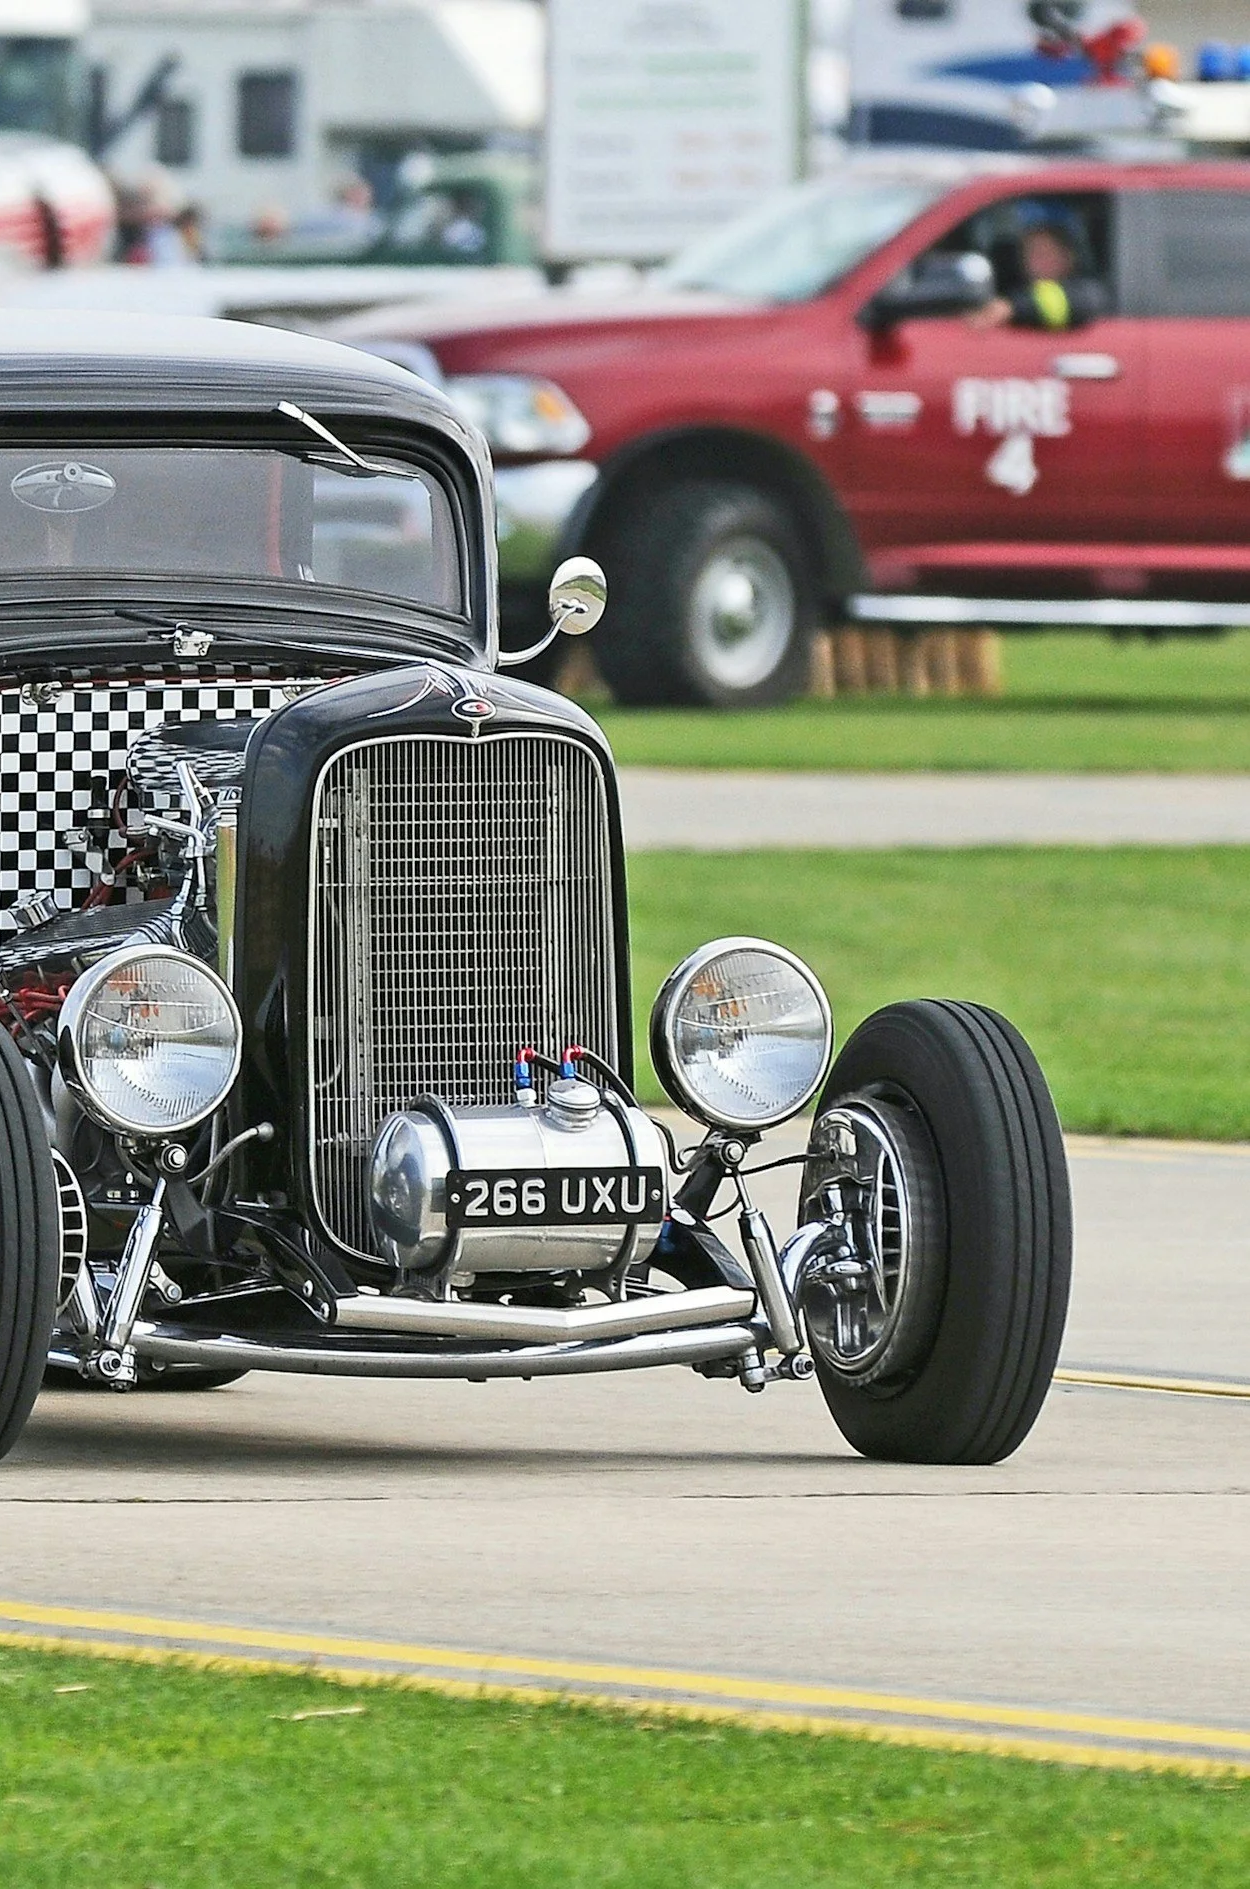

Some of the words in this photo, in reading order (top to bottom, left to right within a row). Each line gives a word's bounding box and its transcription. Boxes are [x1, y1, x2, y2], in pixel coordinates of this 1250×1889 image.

[956, 377, 1071, 437] FIRE
[986, 434, 1038, 495] 4
[464, 1177, 546, 1216] 266
[561, 1175, 647, 1214] UXU
